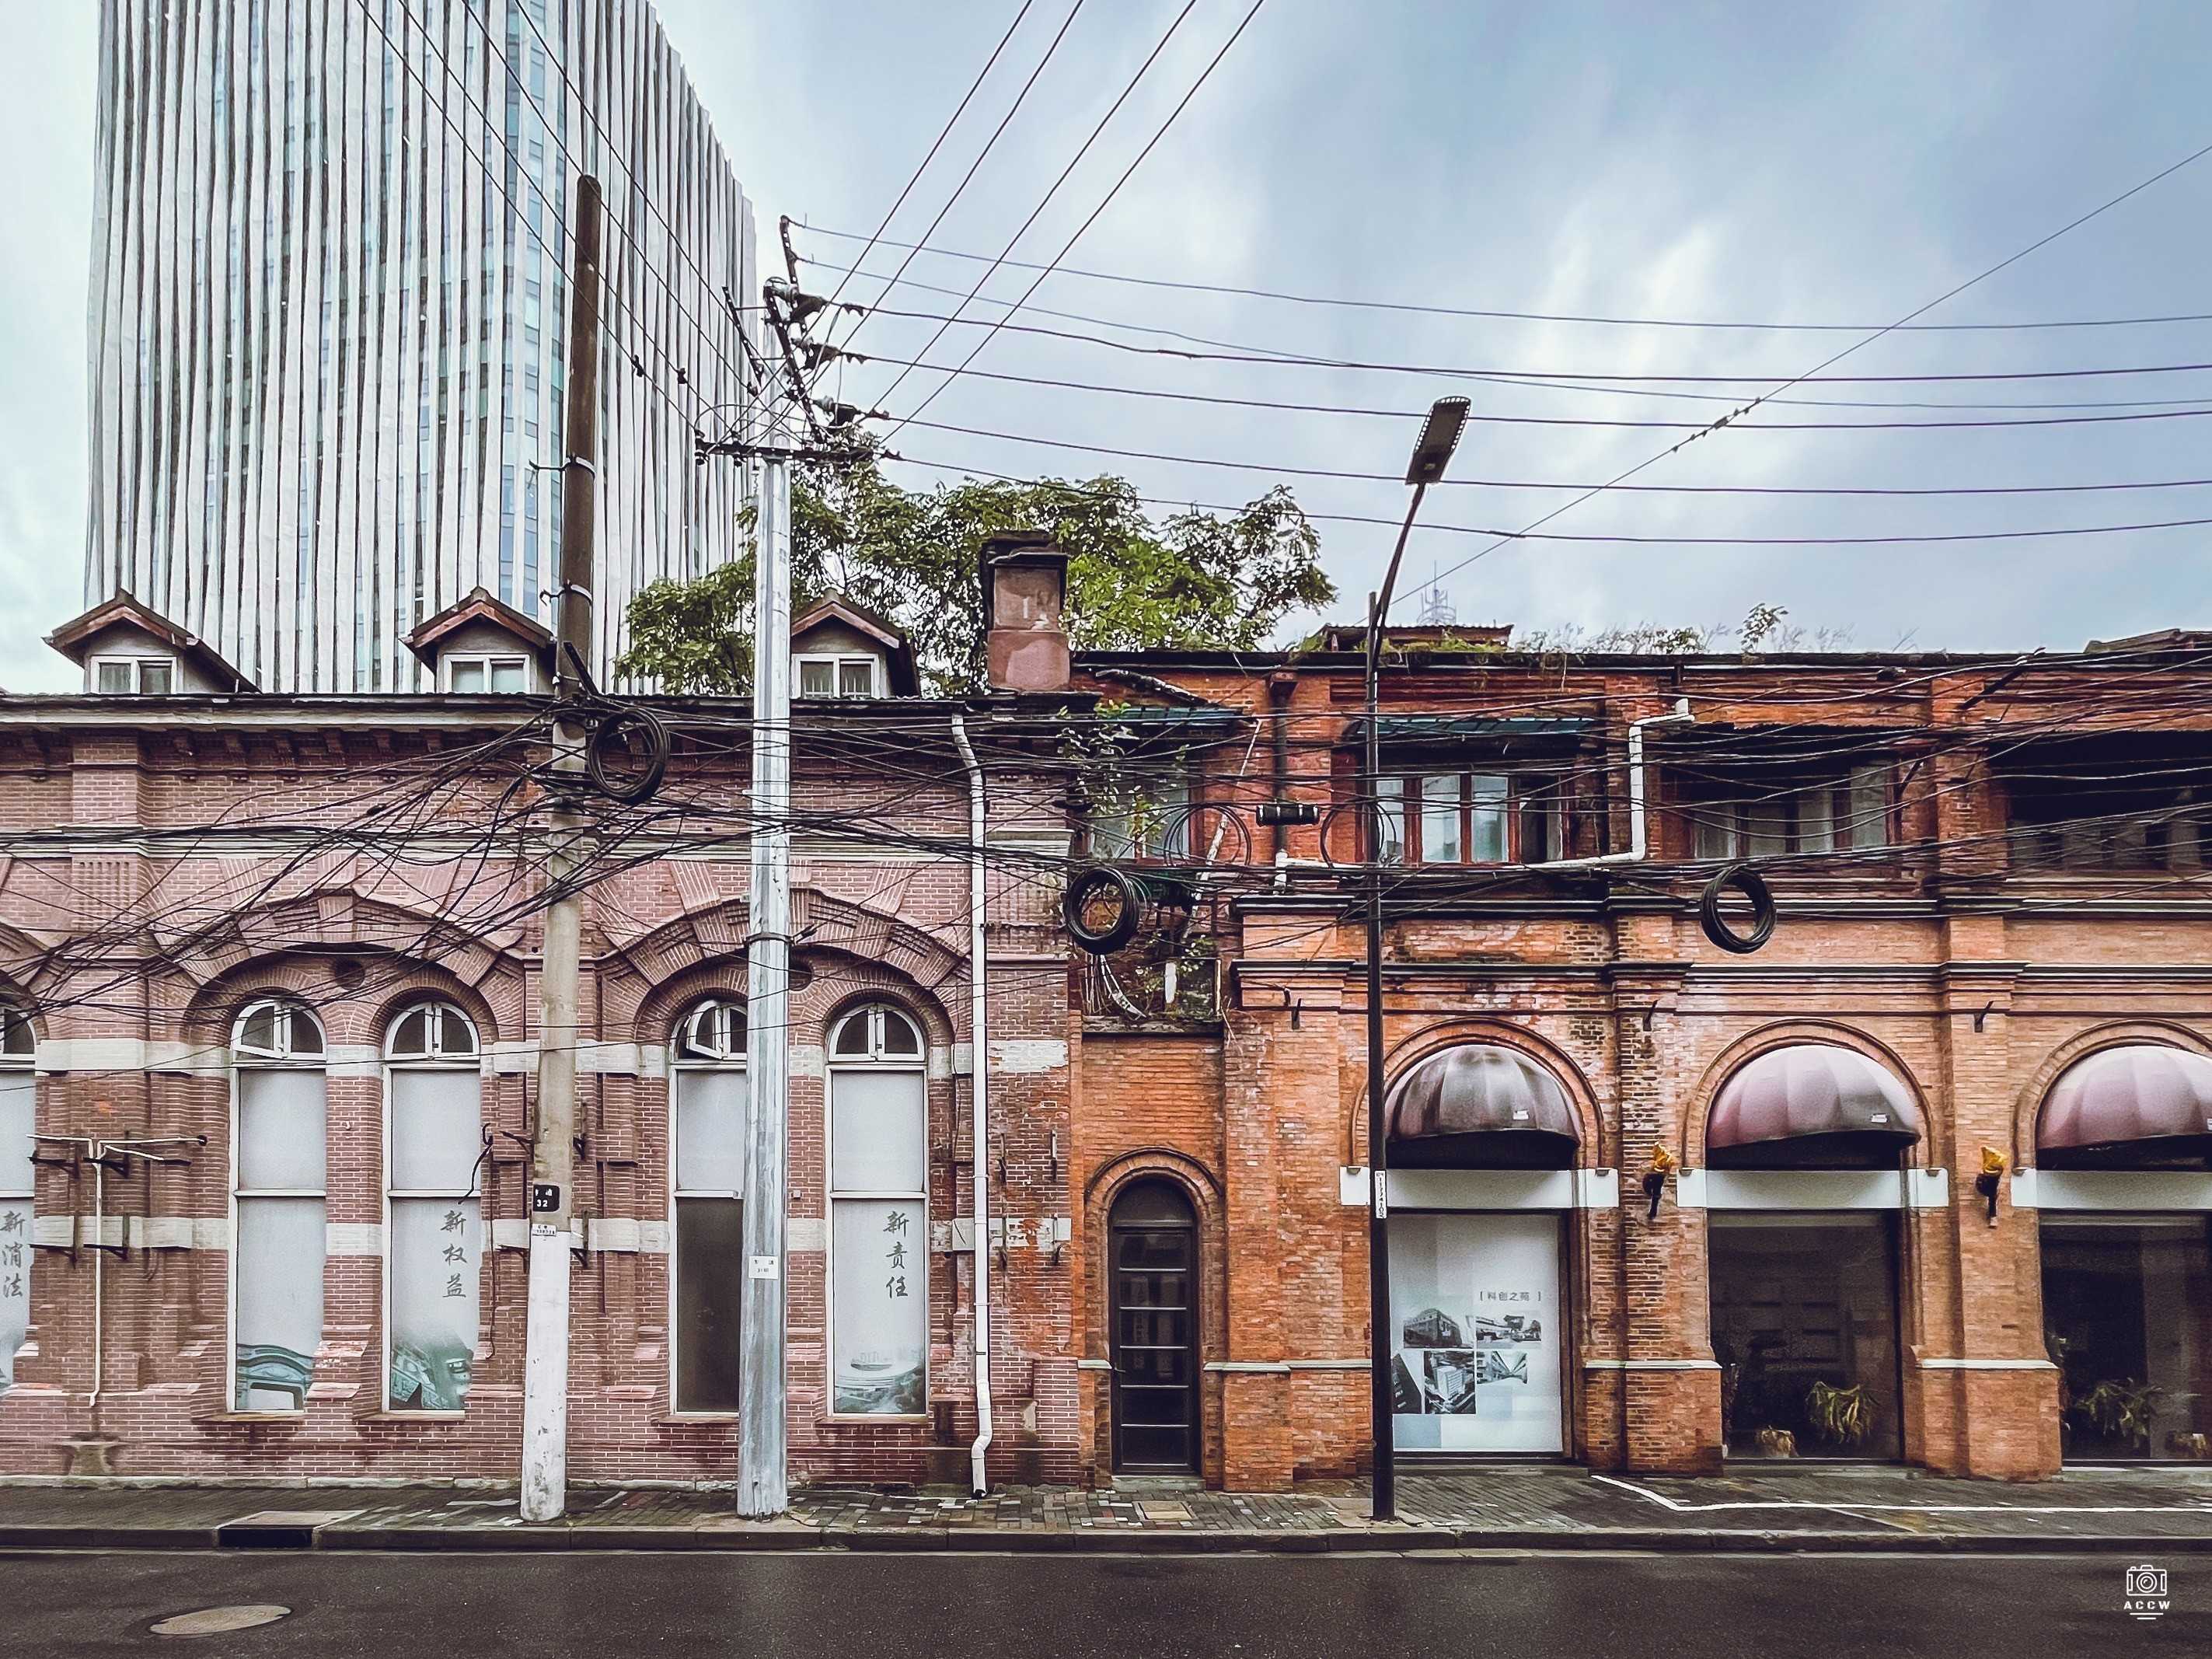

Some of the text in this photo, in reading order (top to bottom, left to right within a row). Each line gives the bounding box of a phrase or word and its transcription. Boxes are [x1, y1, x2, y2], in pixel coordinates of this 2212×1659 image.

[536, 1199, 548, 1207] 32
[0, 1210, 25, 1298] 新消法
[441, 1210, 467, 1298] 新权益
[883, 1211, 909, 1298] 新责任
